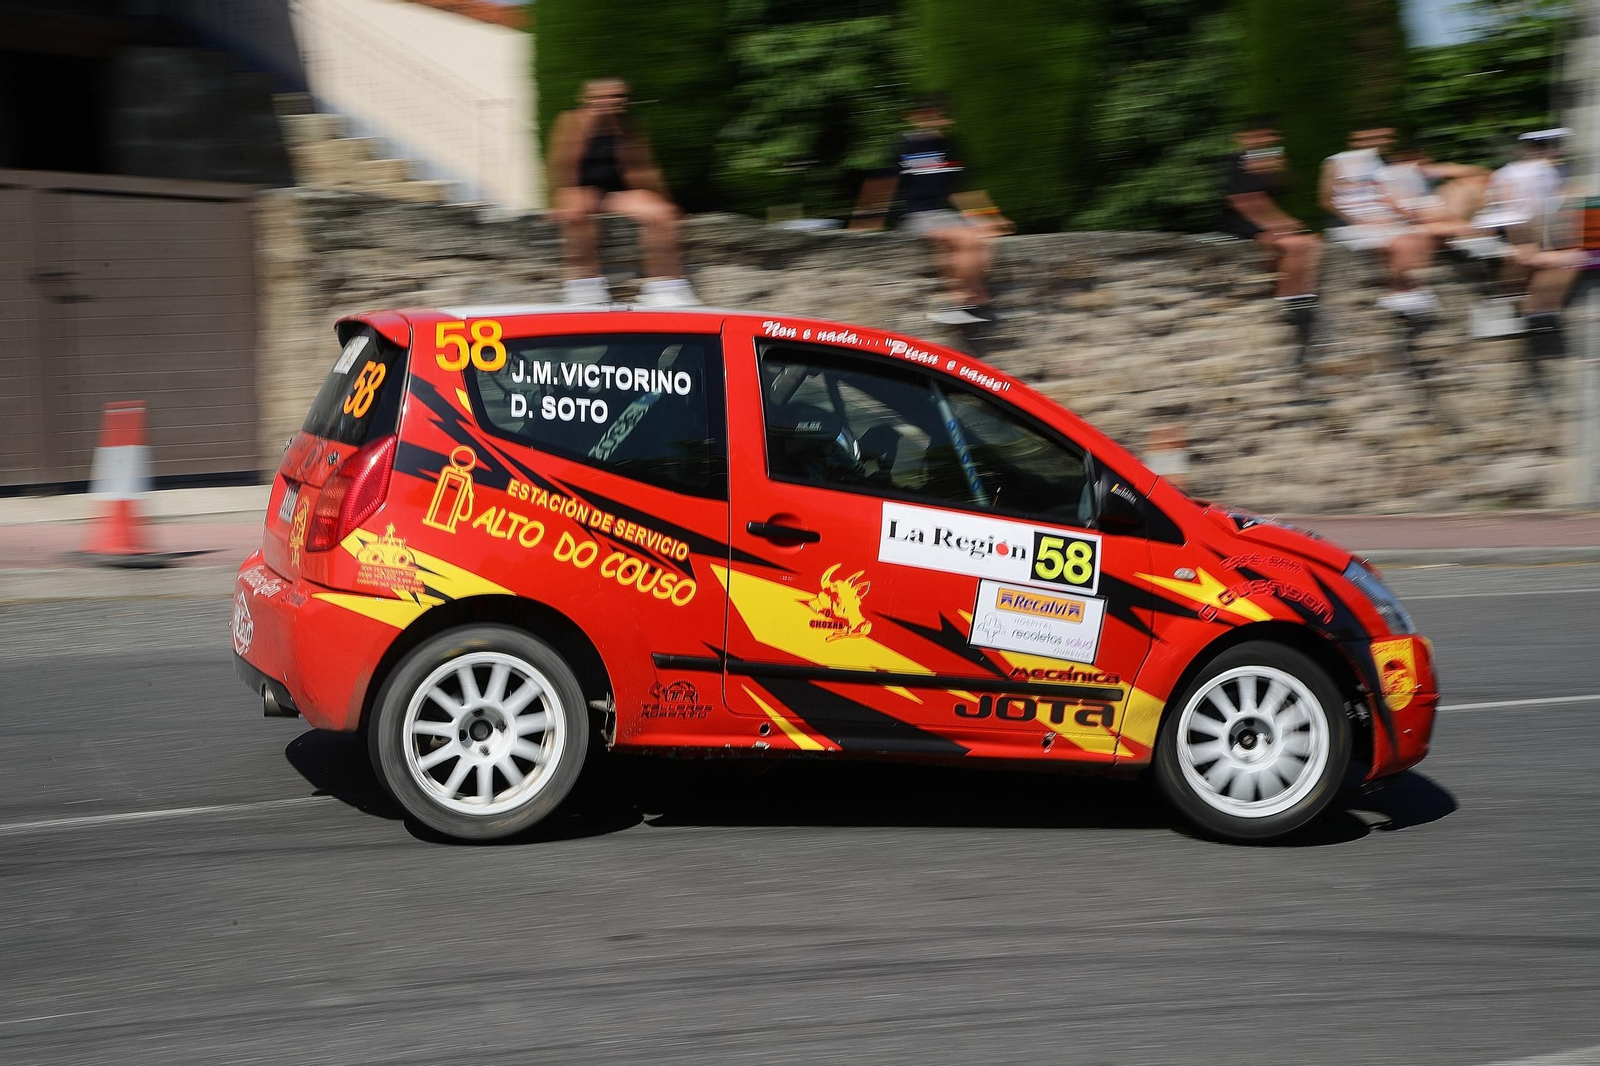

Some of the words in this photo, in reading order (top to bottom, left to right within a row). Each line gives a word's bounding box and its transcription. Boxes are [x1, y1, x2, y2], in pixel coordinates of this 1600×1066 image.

[435, 320, 507, 372] 58
[762, 320, 798, 340] Non
[343, 360, 386, 418] 58
[509, 394, 535, 420] D.
[540, 396, 609, 424] SOTO
[506, 478, 591, 524] ESTACIÓN
[588, 509, 614, 531] DE
[613, 517, 691, 562] SERVICIO
[888, 518, 924, 544] La
[471, 505, 546, 549] ALTO
[553, 530, 601, 569] DO
[598, 551, 699, 608] COUSO
[1034, 535, 1094, 585] 58
[1013, 595, 1070, 616] Recalvi
[1010, 628, 1064, 646] recoletos
[1064, 636, 1094, 651] salud
